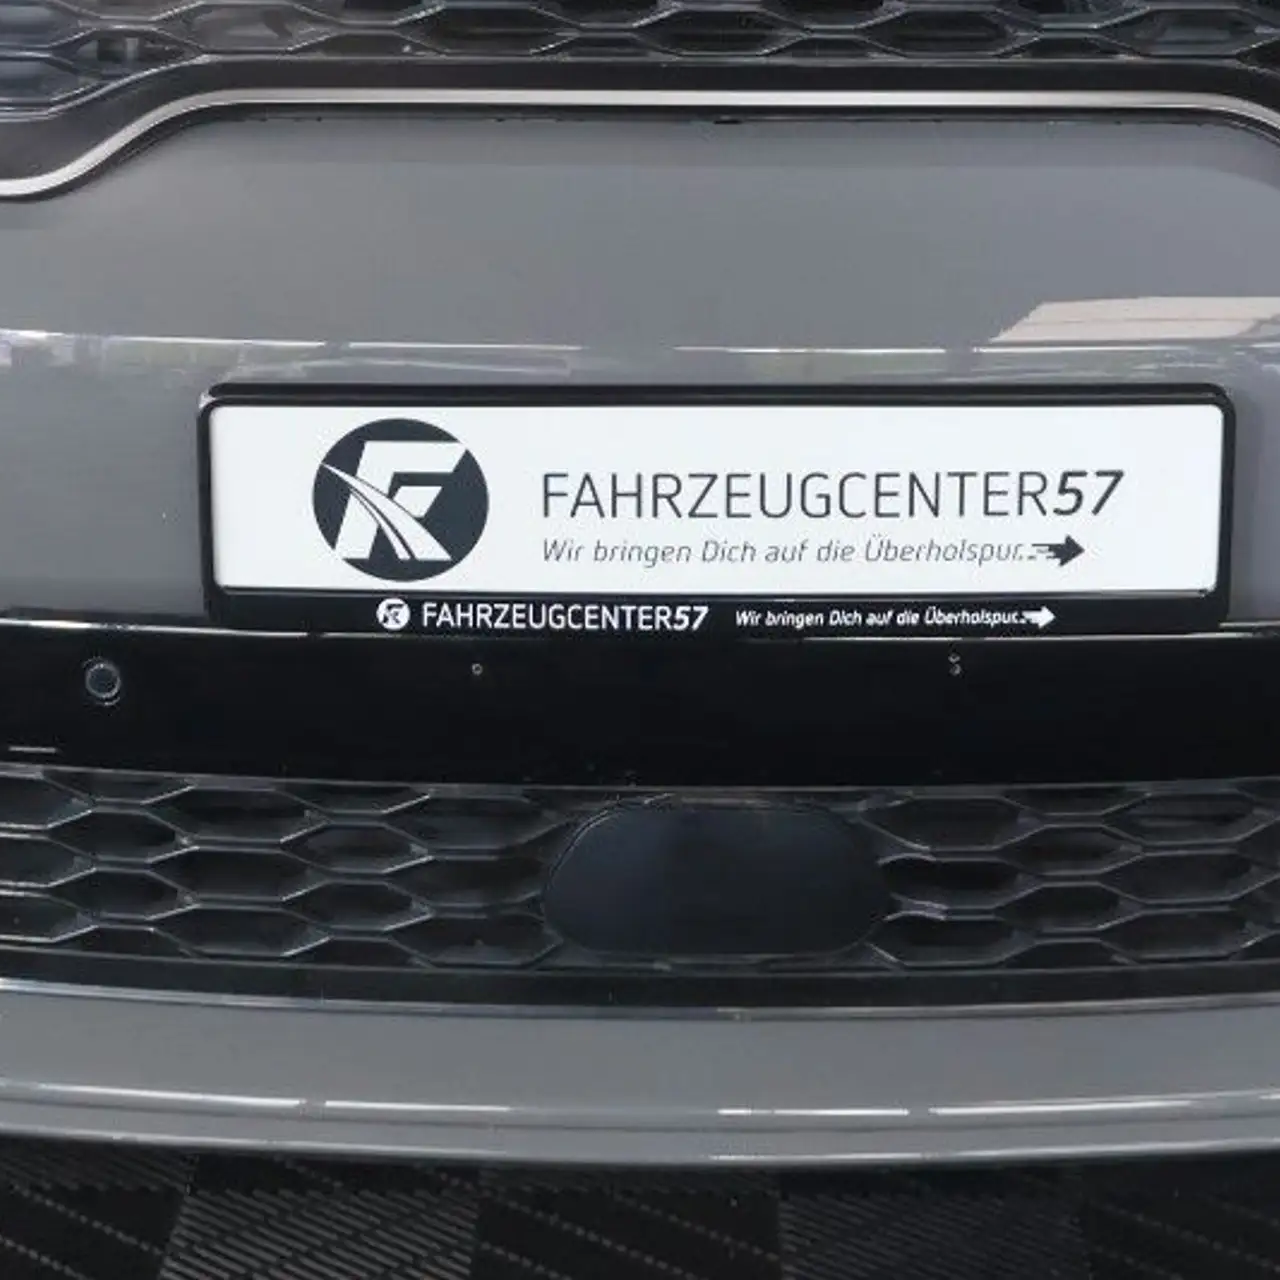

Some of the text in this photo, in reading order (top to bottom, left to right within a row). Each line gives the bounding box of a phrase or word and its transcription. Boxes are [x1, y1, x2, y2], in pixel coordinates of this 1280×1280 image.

[542, 470, 1124, 519] FAHRZEUGCENTER57
[542, 538, 584, 562] Wir
[593, 538, 691, 568] bringen
[700, 538, 756, 562] Dich
[764, 538, 808, 562] auf
[816, 537, 856, 562] die
[422, 602, 709, 631] FAHRZEUGCENTER57
[735, 610, 761, 625] Wir
[765, 609, 824, 629] bringen
[829, 608, 862, 625] Dich
[866, 609, 892, 625] auf
[896, 608, 920, 624] die
